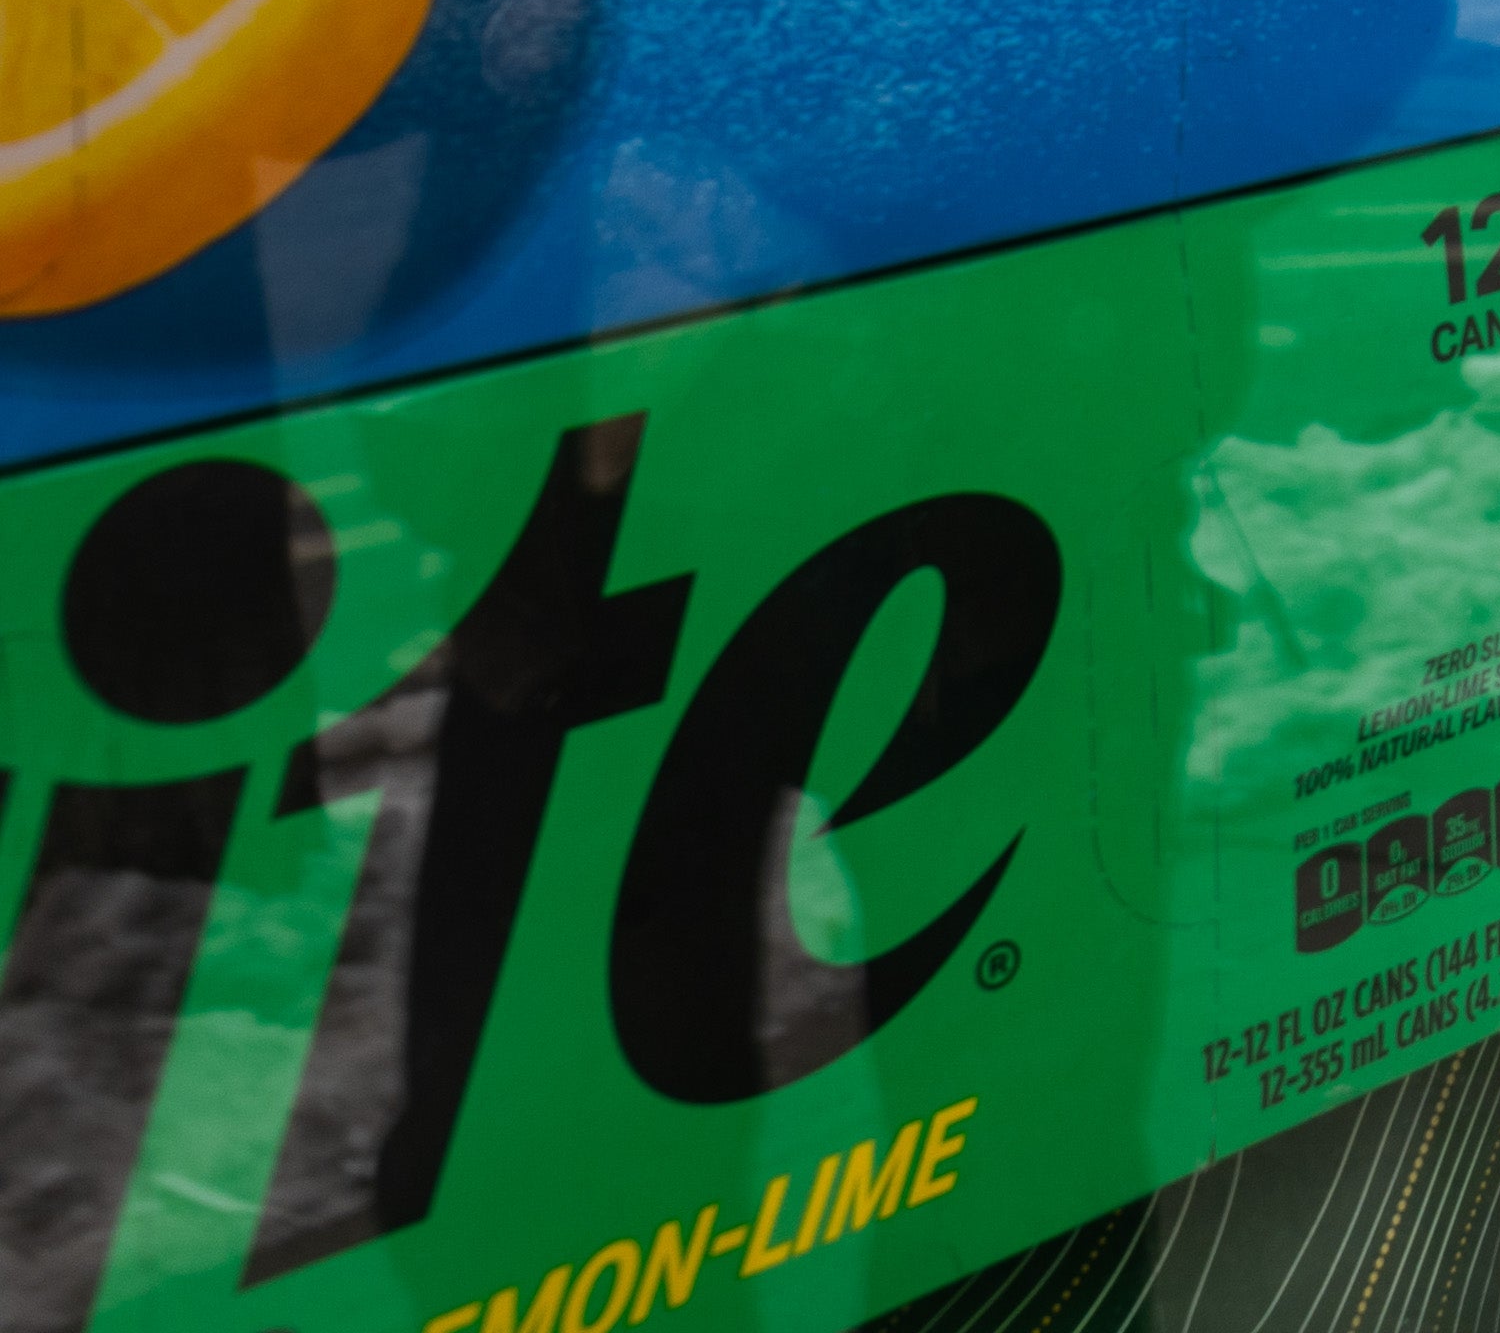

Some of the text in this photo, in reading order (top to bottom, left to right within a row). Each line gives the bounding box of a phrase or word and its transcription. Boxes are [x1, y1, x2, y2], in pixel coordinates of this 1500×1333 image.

[1423, 641, 1479, 686] ZERO
[1357, 667, 1496, 743] LEMON-LIME
[1294, 755, 1355, 800] 100%
[1356, 721, 1456, 777] NATURAL
[0, 411, 1063, 1333] ite
